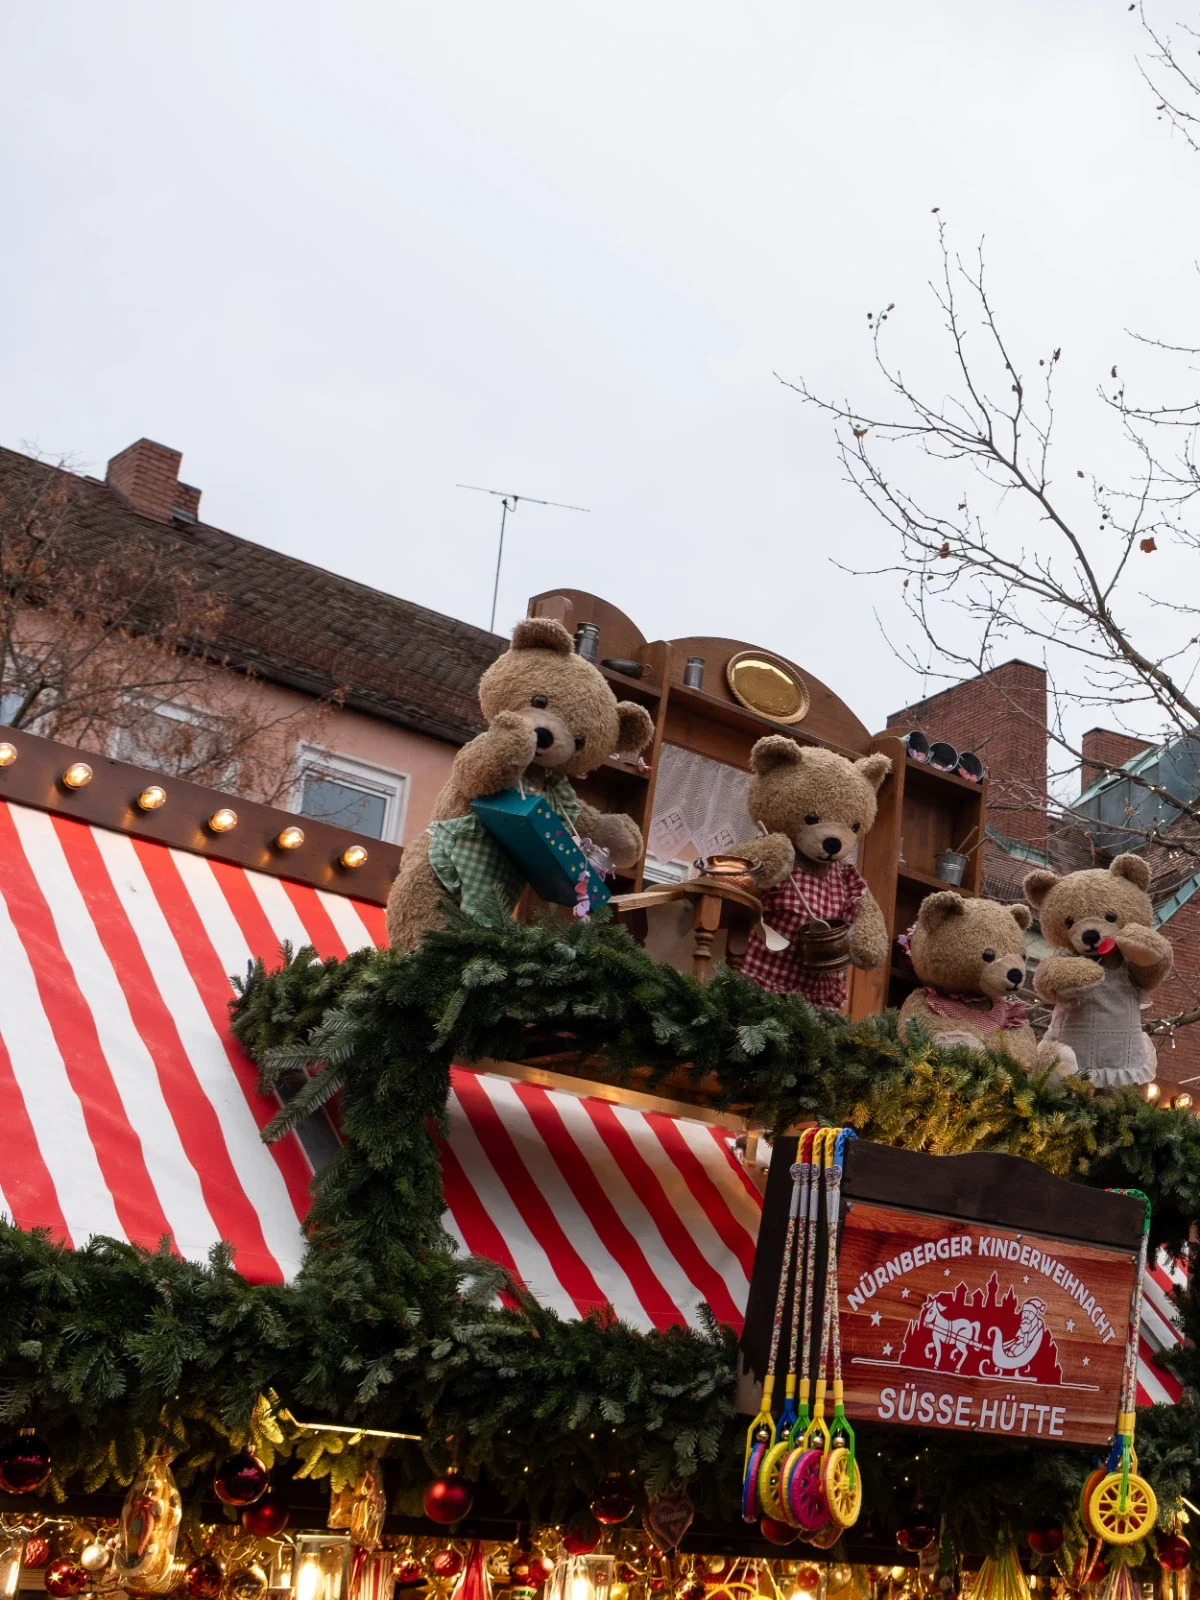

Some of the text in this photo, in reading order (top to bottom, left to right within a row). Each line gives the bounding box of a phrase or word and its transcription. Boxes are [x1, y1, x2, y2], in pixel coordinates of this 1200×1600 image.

[847, 1236, 1116, 1344] NÜRNBERGER KINDERWEIHNACHT
[877, 1382, 1067, 1436] SÜSSE HÜTTE
